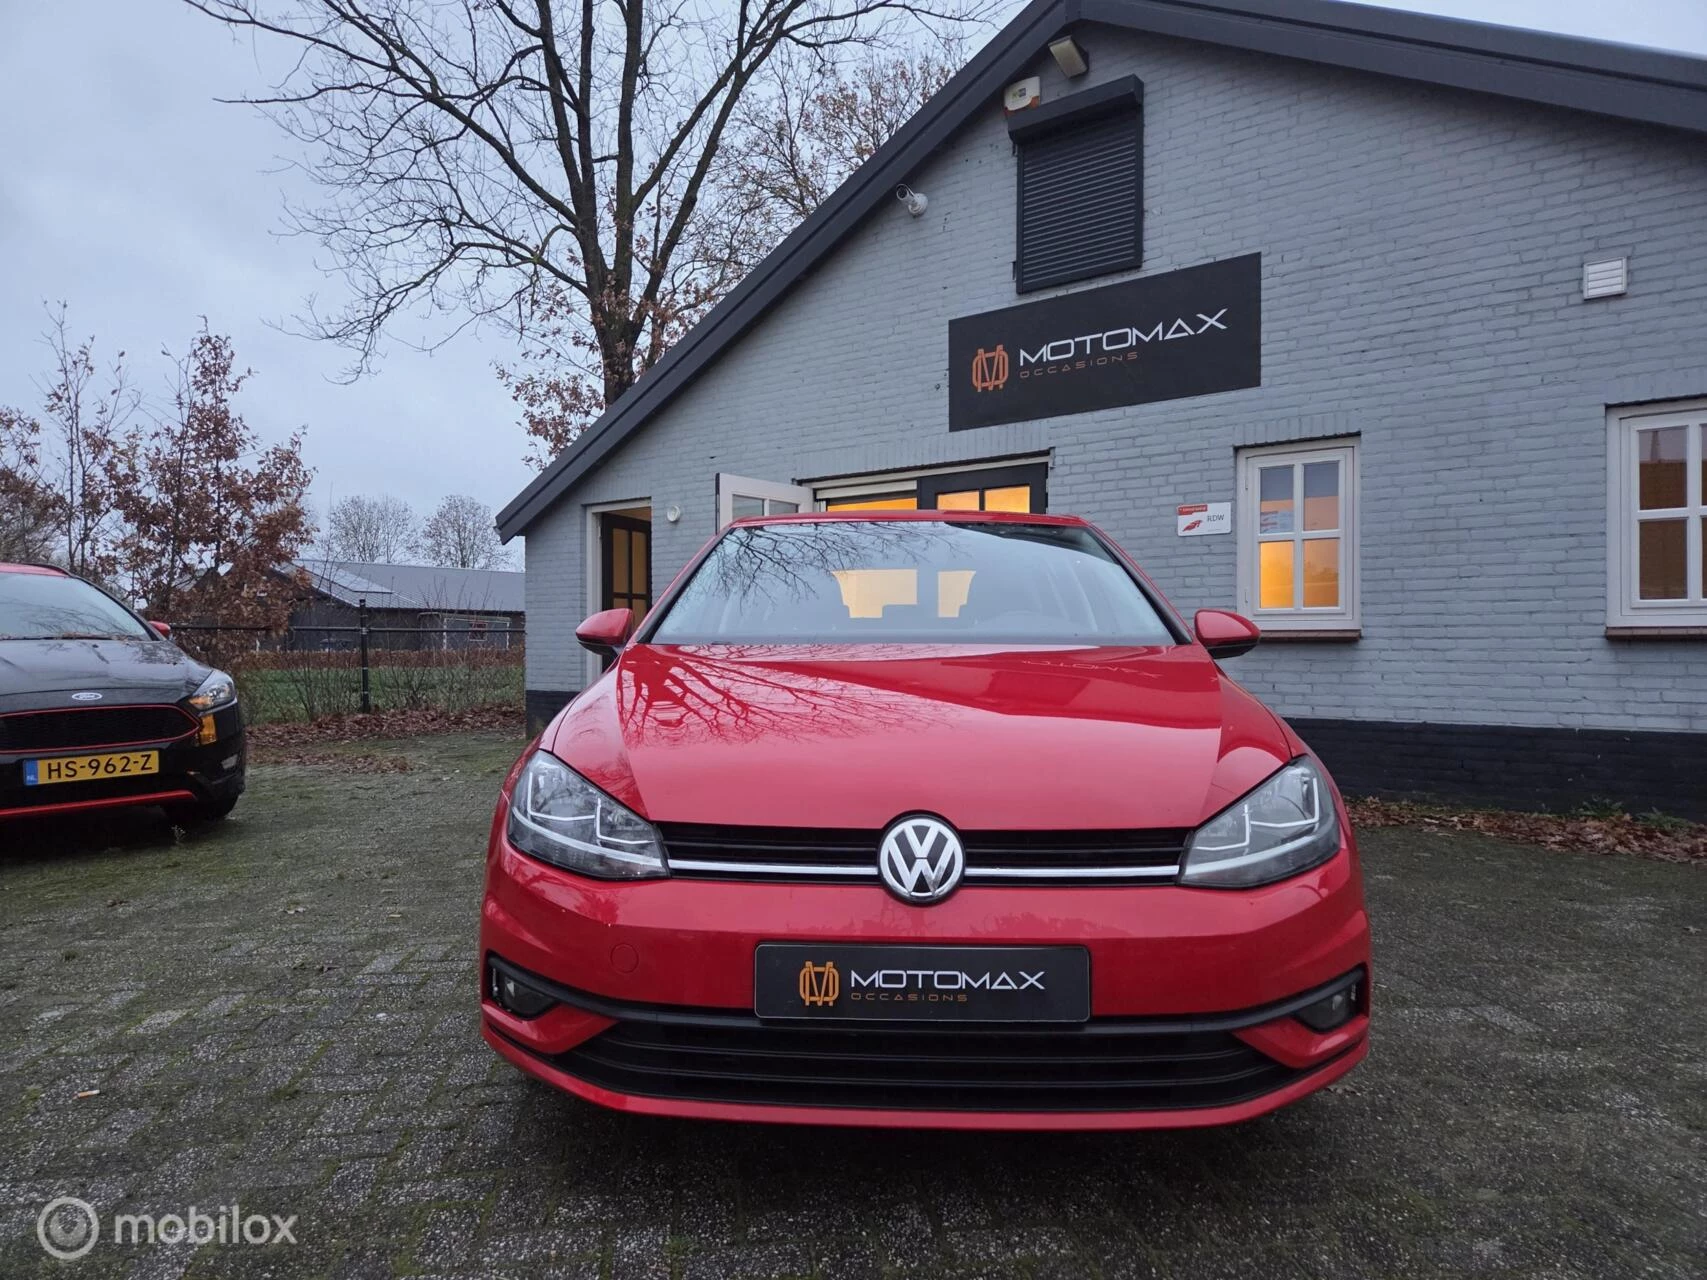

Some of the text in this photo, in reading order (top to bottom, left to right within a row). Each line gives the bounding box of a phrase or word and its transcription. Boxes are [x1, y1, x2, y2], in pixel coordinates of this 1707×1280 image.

[1019, 308, 1228, 366] MOTOMAX
[1019, 351, 1139, 379] OCCASIONS
[47, 753, 153, 780] HS-962-Z
[850, 969, 1046, 990] MOTOMAX
[850, 992, 969, 1002] OCCASIONS
